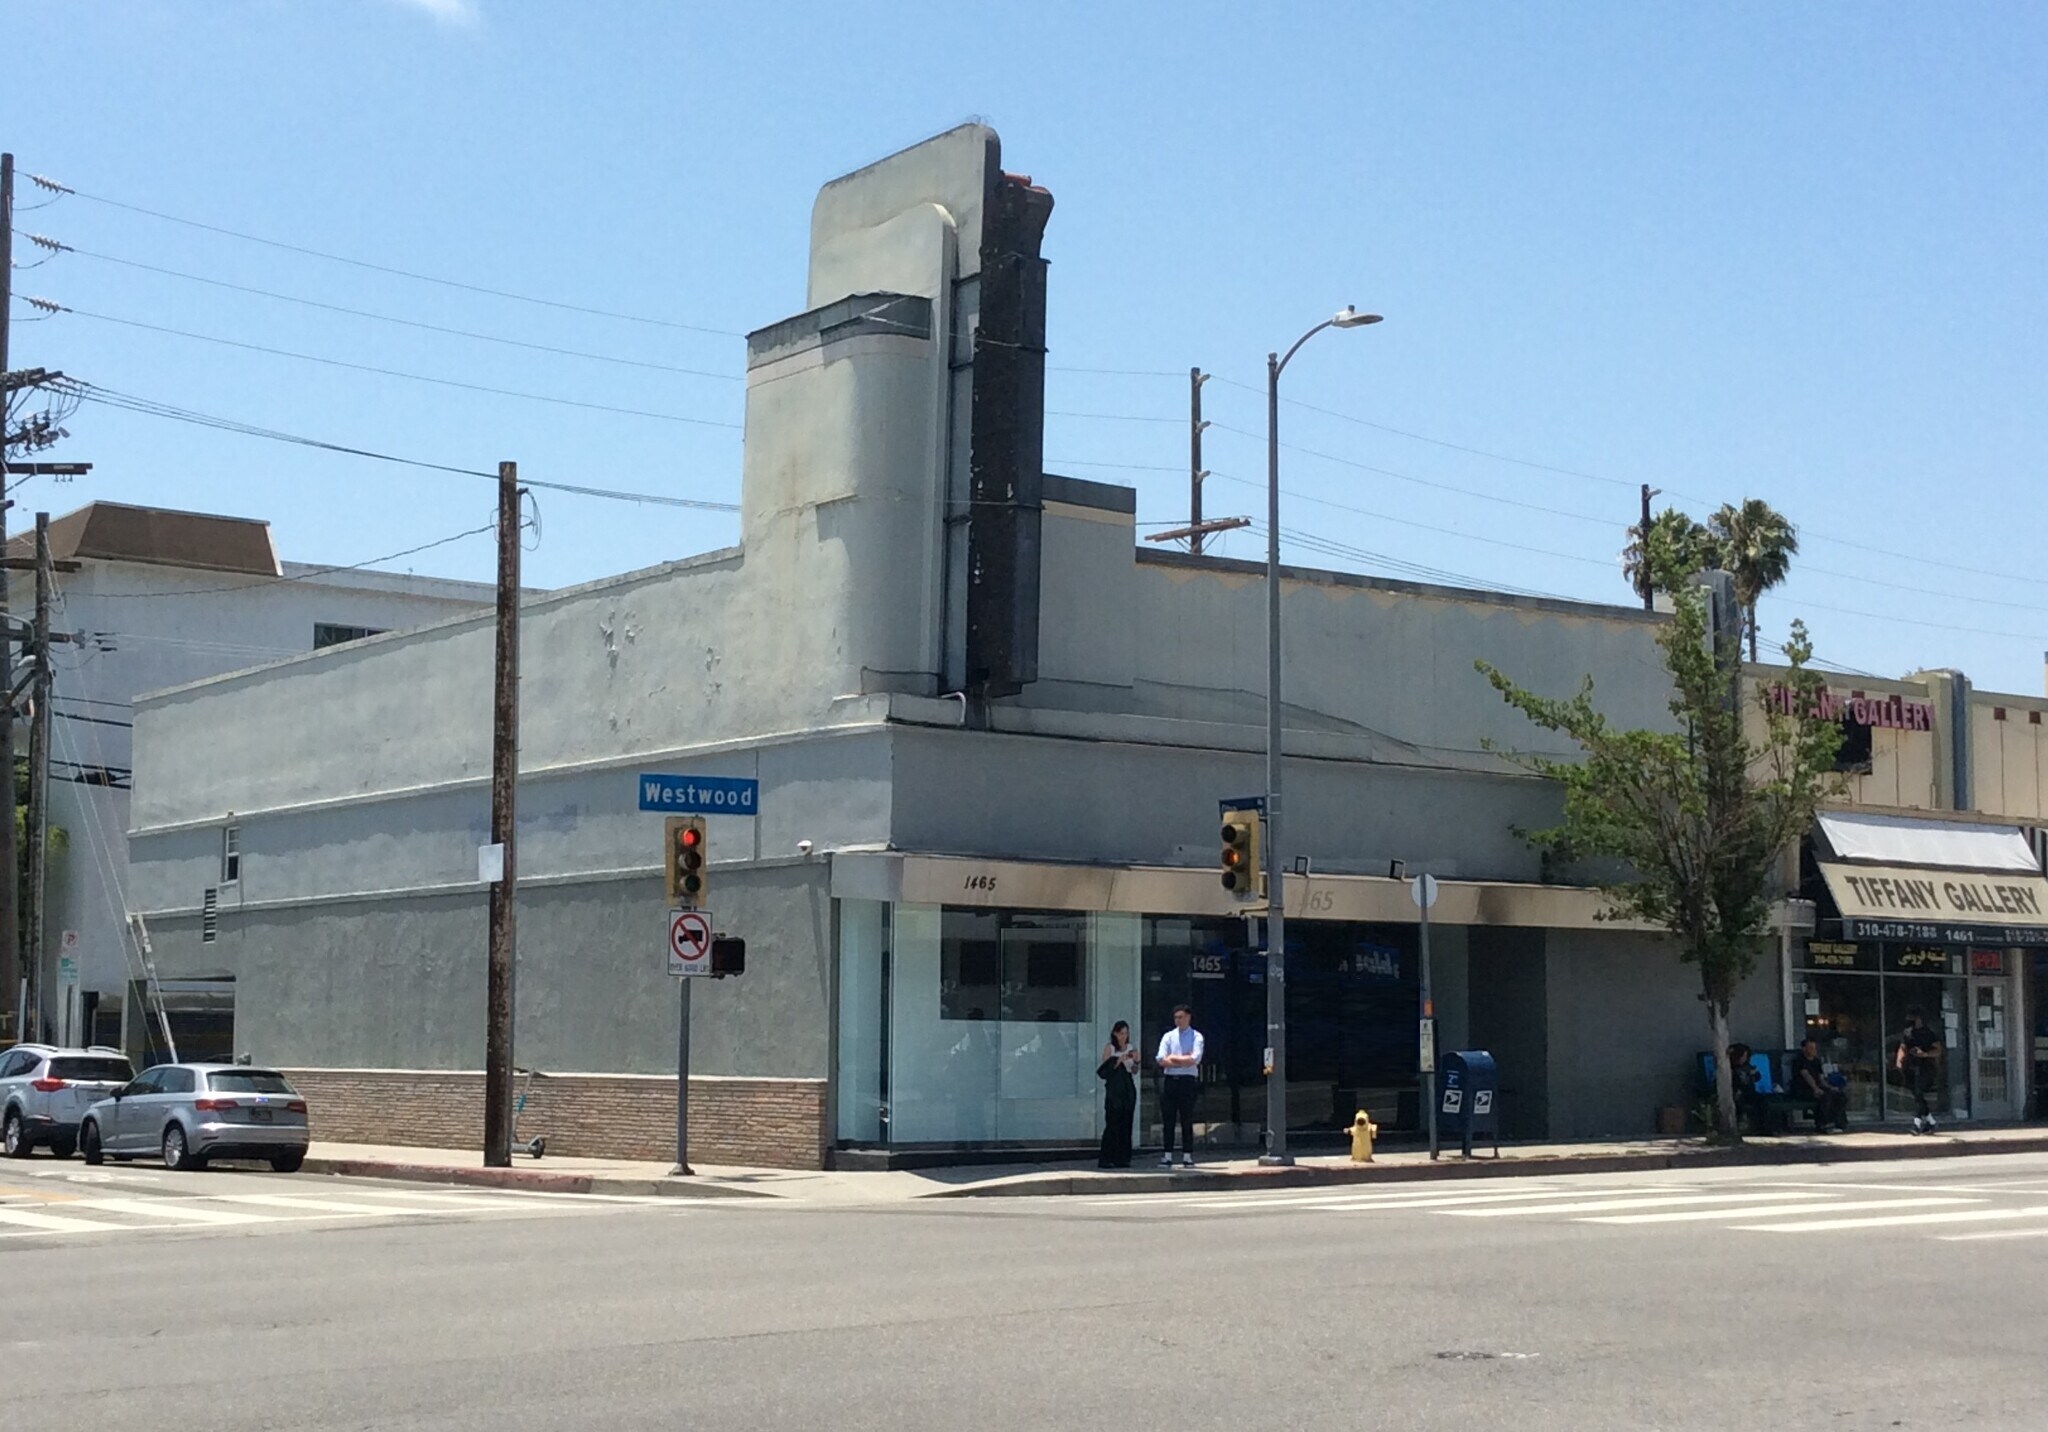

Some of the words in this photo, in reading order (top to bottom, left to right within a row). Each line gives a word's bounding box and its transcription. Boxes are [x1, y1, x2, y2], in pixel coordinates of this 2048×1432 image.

[1769, 685, 1849, 722] TIFANY
[1853, 697, 1935, 731] GALLERY
[645, 782, 752, 806] Westwood
[963, 875, 997, 891] 1465
[1844, 875, 1941, 910] TIFFANY
[1943, 881, 2042, 915] GALLERY
[1945, 929, 1974, 942] 1461
[1192, 956, 1221, 971] 1465
